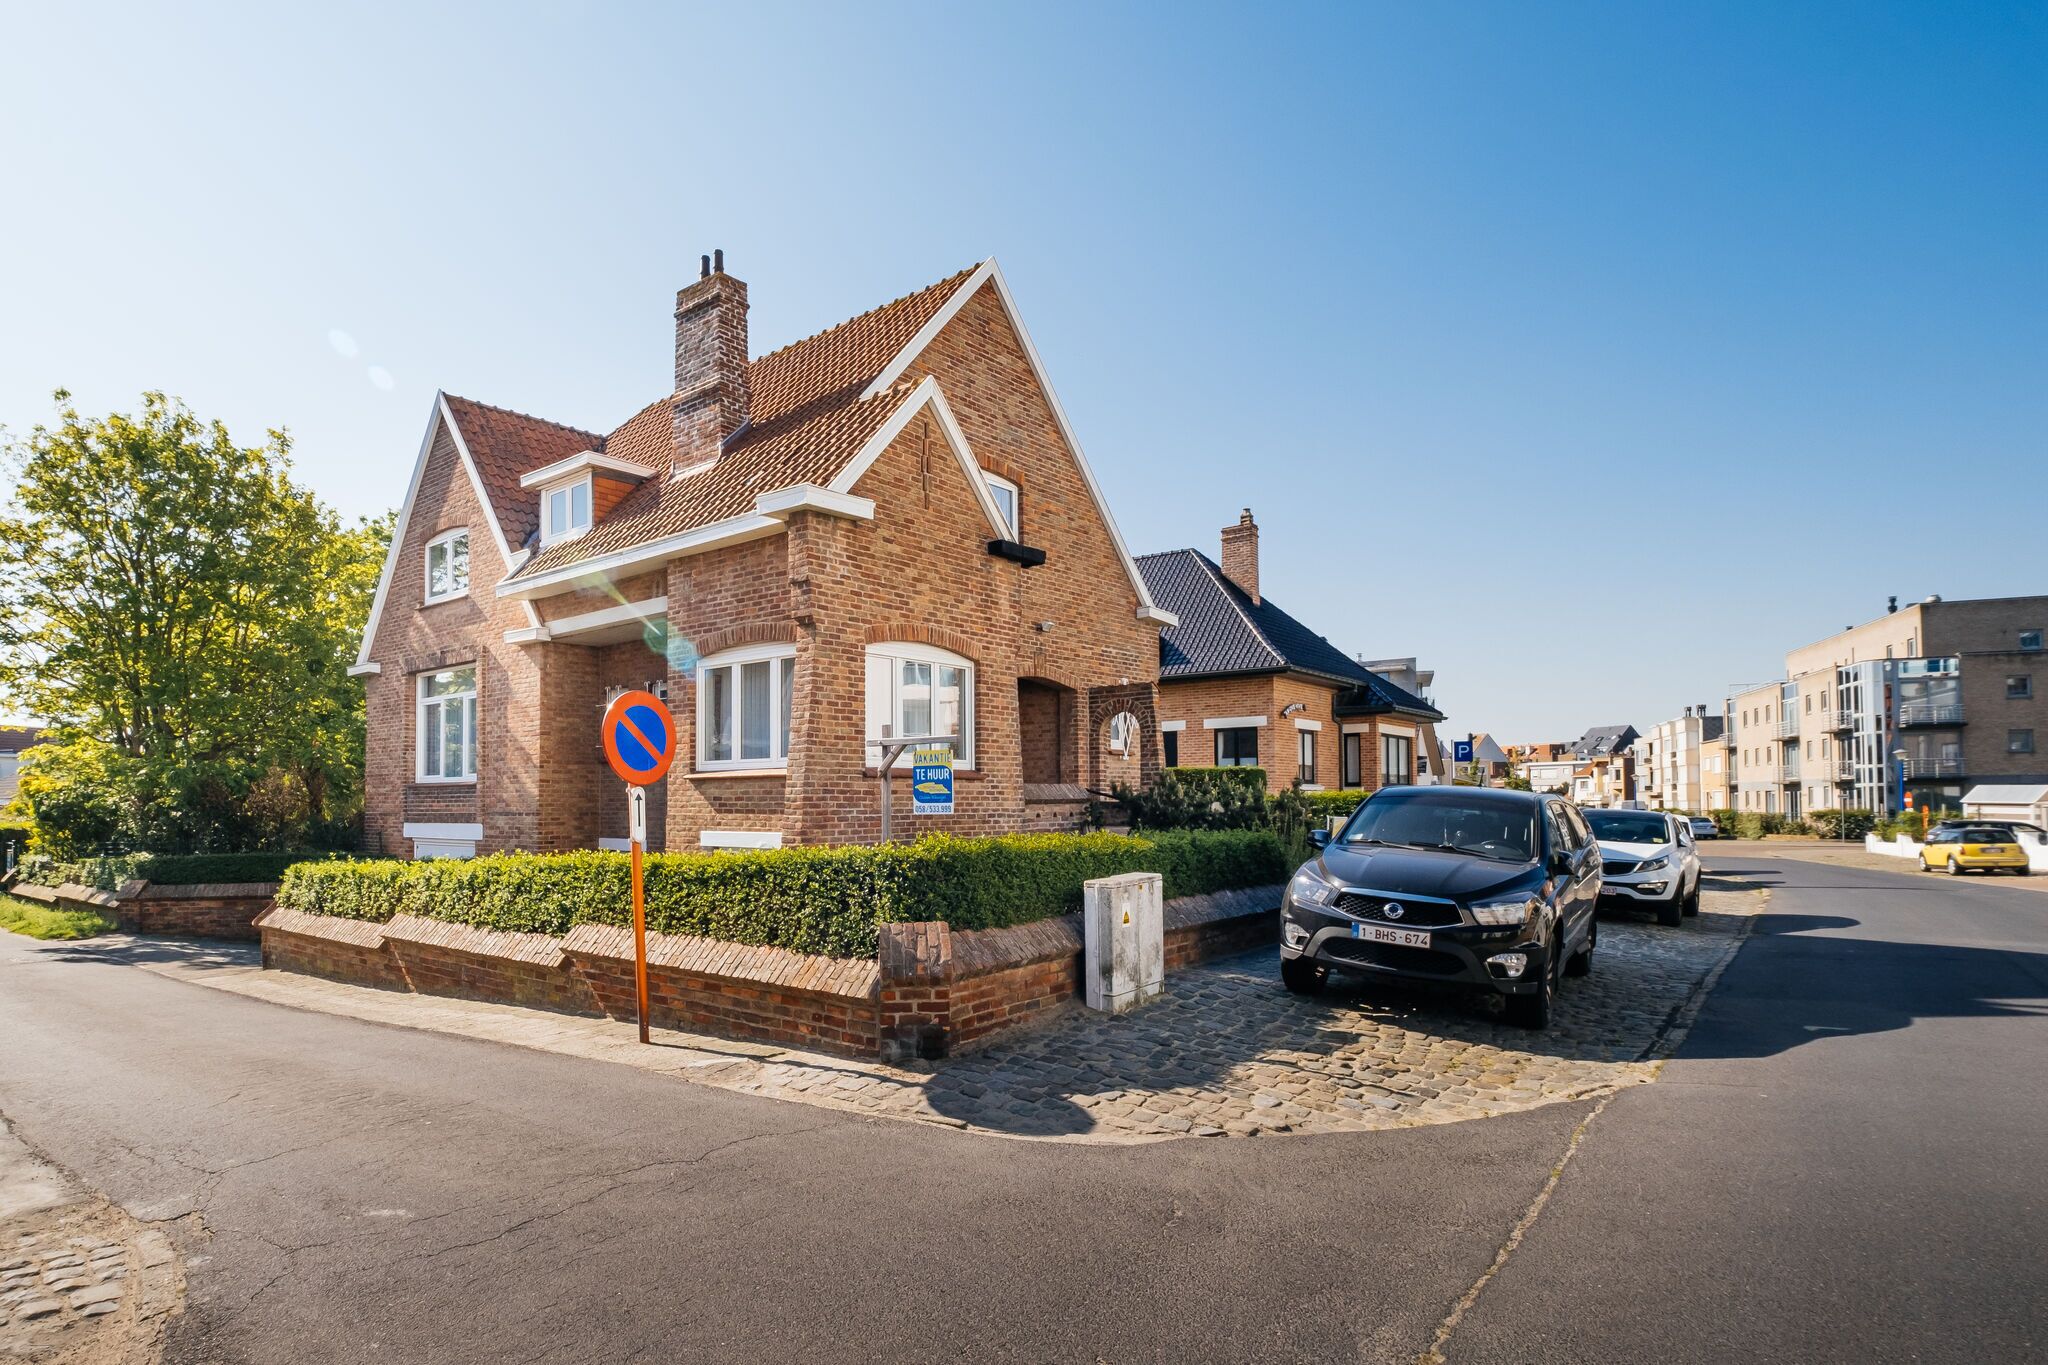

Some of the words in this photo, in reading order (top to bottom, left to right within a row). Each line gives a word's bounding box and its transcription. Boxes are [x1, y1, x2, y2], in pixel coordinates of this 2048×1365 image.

[1458, 745, 1470, 758] P
[913, 752, 951, 764] VAKANTIE
[915, 768, 926, 780] TE
[927, 768, 950, 780] HUUR
